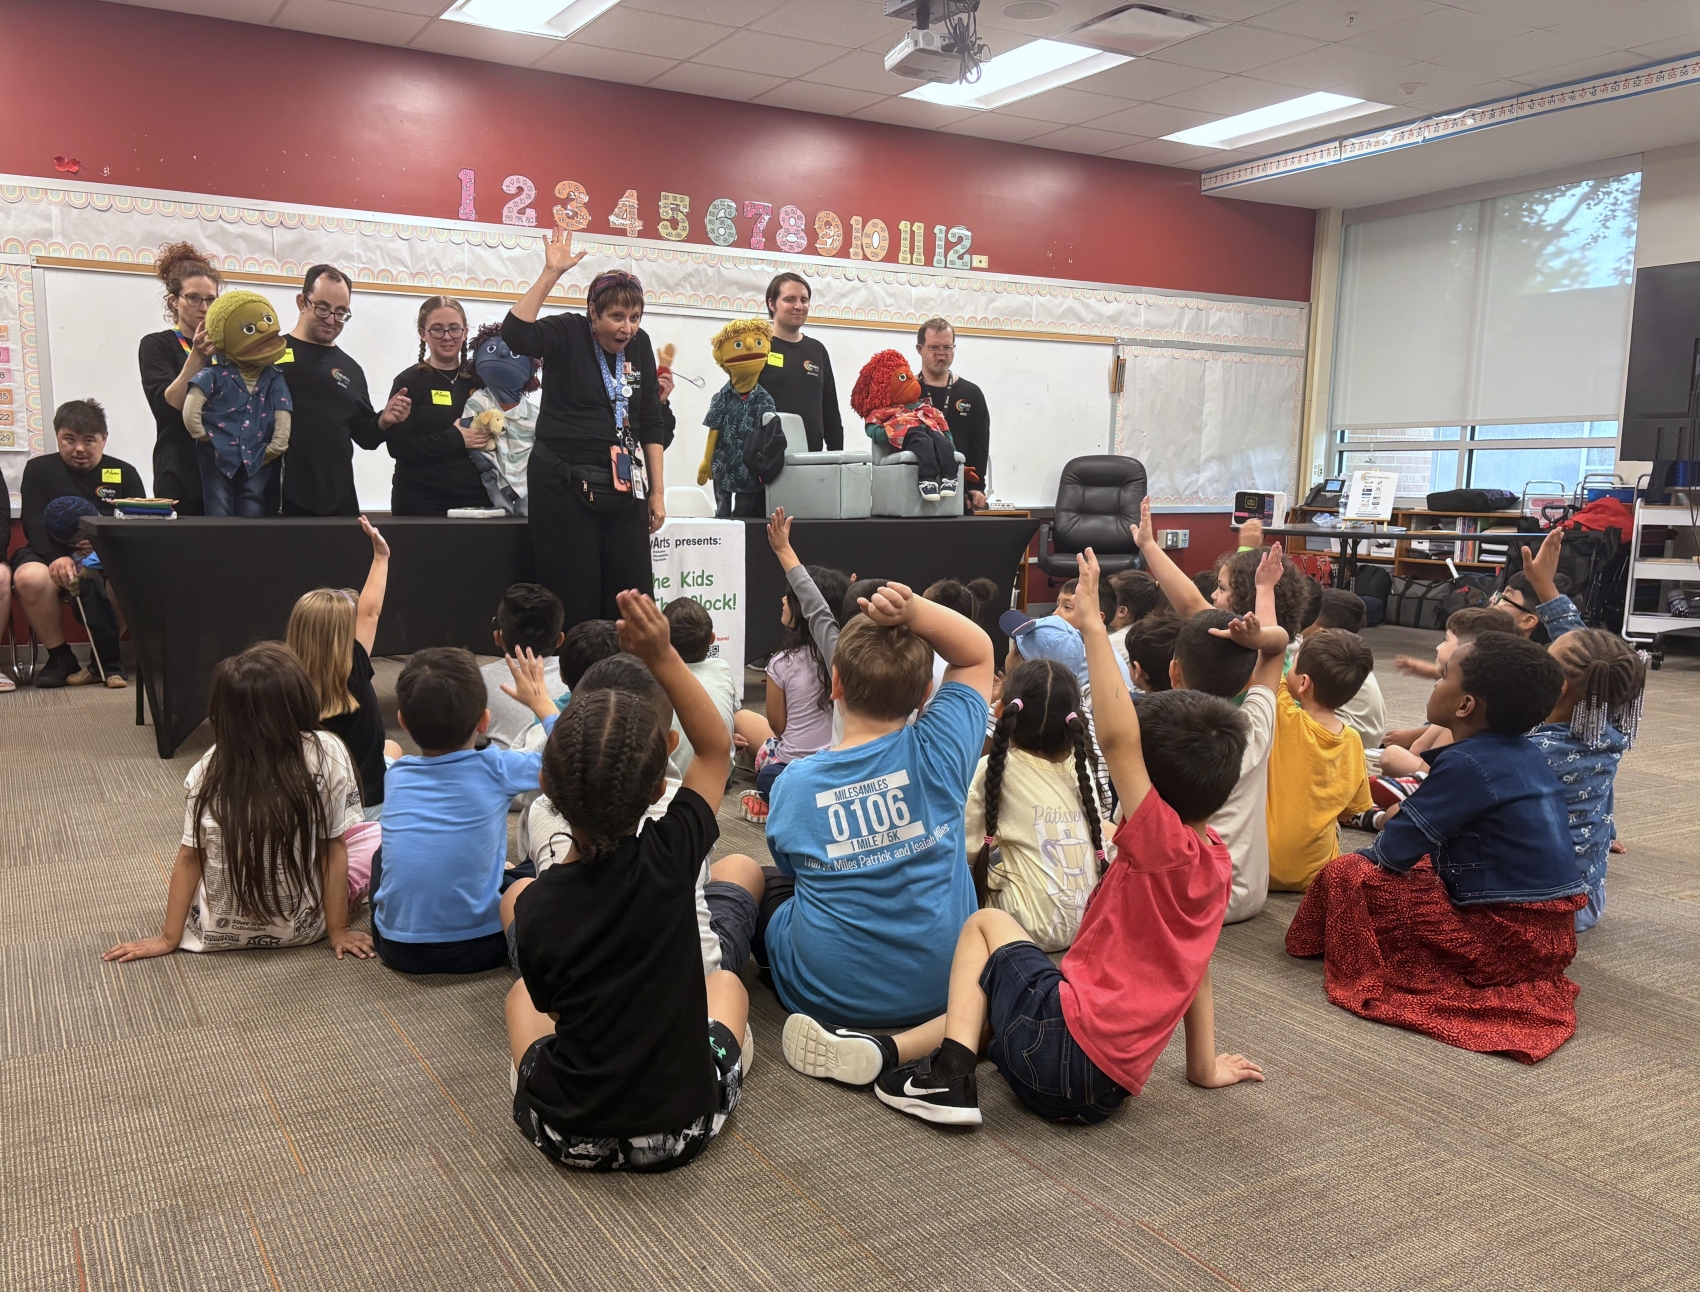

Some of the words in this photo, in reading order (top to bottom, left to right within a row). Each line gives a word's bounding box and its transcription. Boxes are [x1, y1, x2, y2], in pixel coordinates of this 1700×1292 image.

[1656, 74, 1665, 82] 54
[458, 168, 476, 220] 1
[502, 174, 536, 226] 2
[554, 180, 590, 230] 3
[610, 189, 640, 237] 4
[658, 192, 690, 241] 5
[706, 198, 737, 246] 6
[744, 201, 772, 250] 7
[776, 205, 807, 252] 8
[814, 210, 843, 257] 9
[850, 216, 889, 262] 10
[898, 220, 924, 265] 11
[933, 224, 972, 270] 12
[675, 536, 721, 548] presents:
[680, 569, 714, 588] Kids
[834, 778, 888, 802] MILES4MILES
[828, 788, 911, 842] 0106
[833, 859, 858, 872] Miles
[859, 850, 892, 868] Patrick
[894, 844, 911, 858] and
[912, 836, 937, 853] Isaiah
[934, 823, 950, 842] Miles
[850, 842, 856, 852] 1
[857, 836, 878, 850] MILE
[887, 830, 900, 842] 5K
[826, 1045, 837, 1072] NIKE
